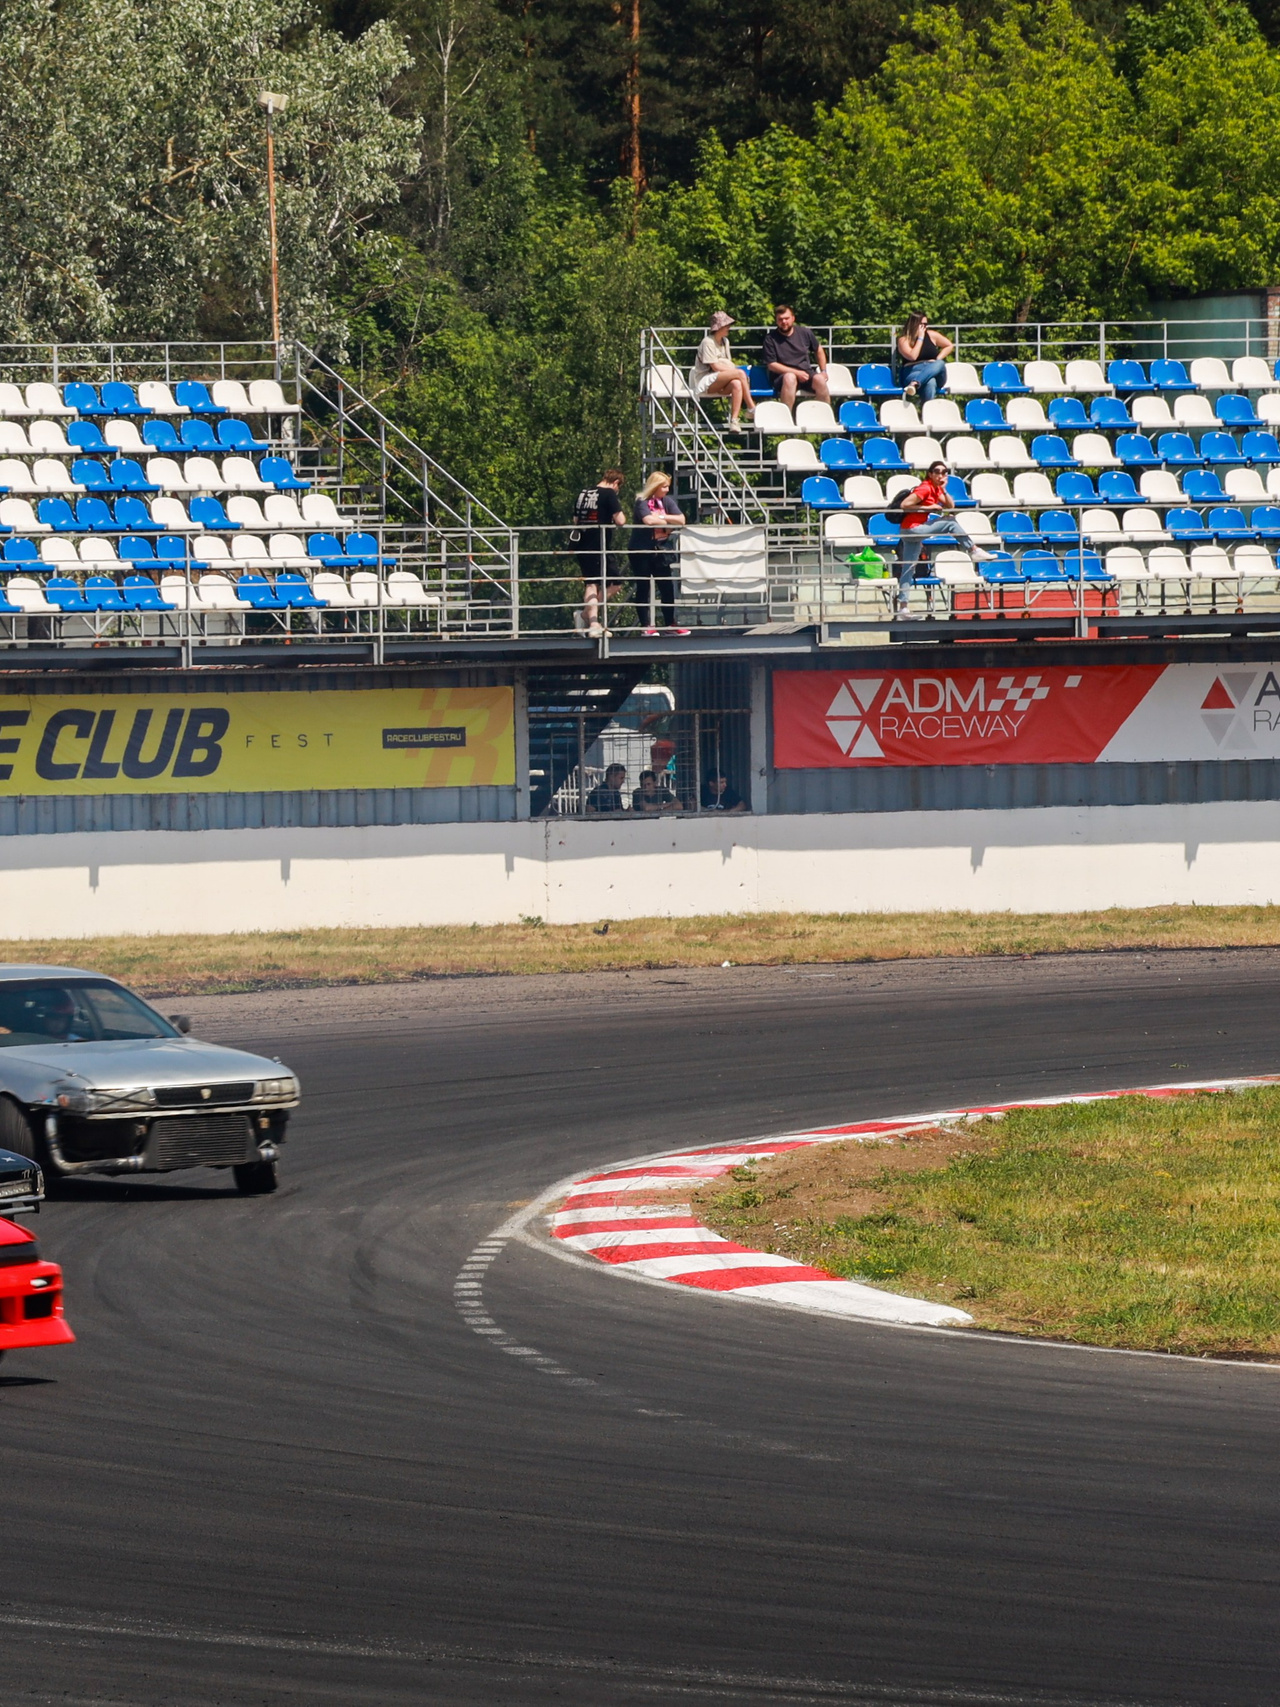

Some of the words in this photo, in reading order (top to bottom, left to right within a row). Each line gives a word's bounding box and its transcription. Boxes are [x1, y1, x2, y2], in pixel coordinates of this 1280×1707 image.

[880, 677, 985, 713] ADM
[245, 733, 334, 748] FEST
[880, 714, 1026, 739] RACEWAY
[35, 707, 230, 781] CLUB
